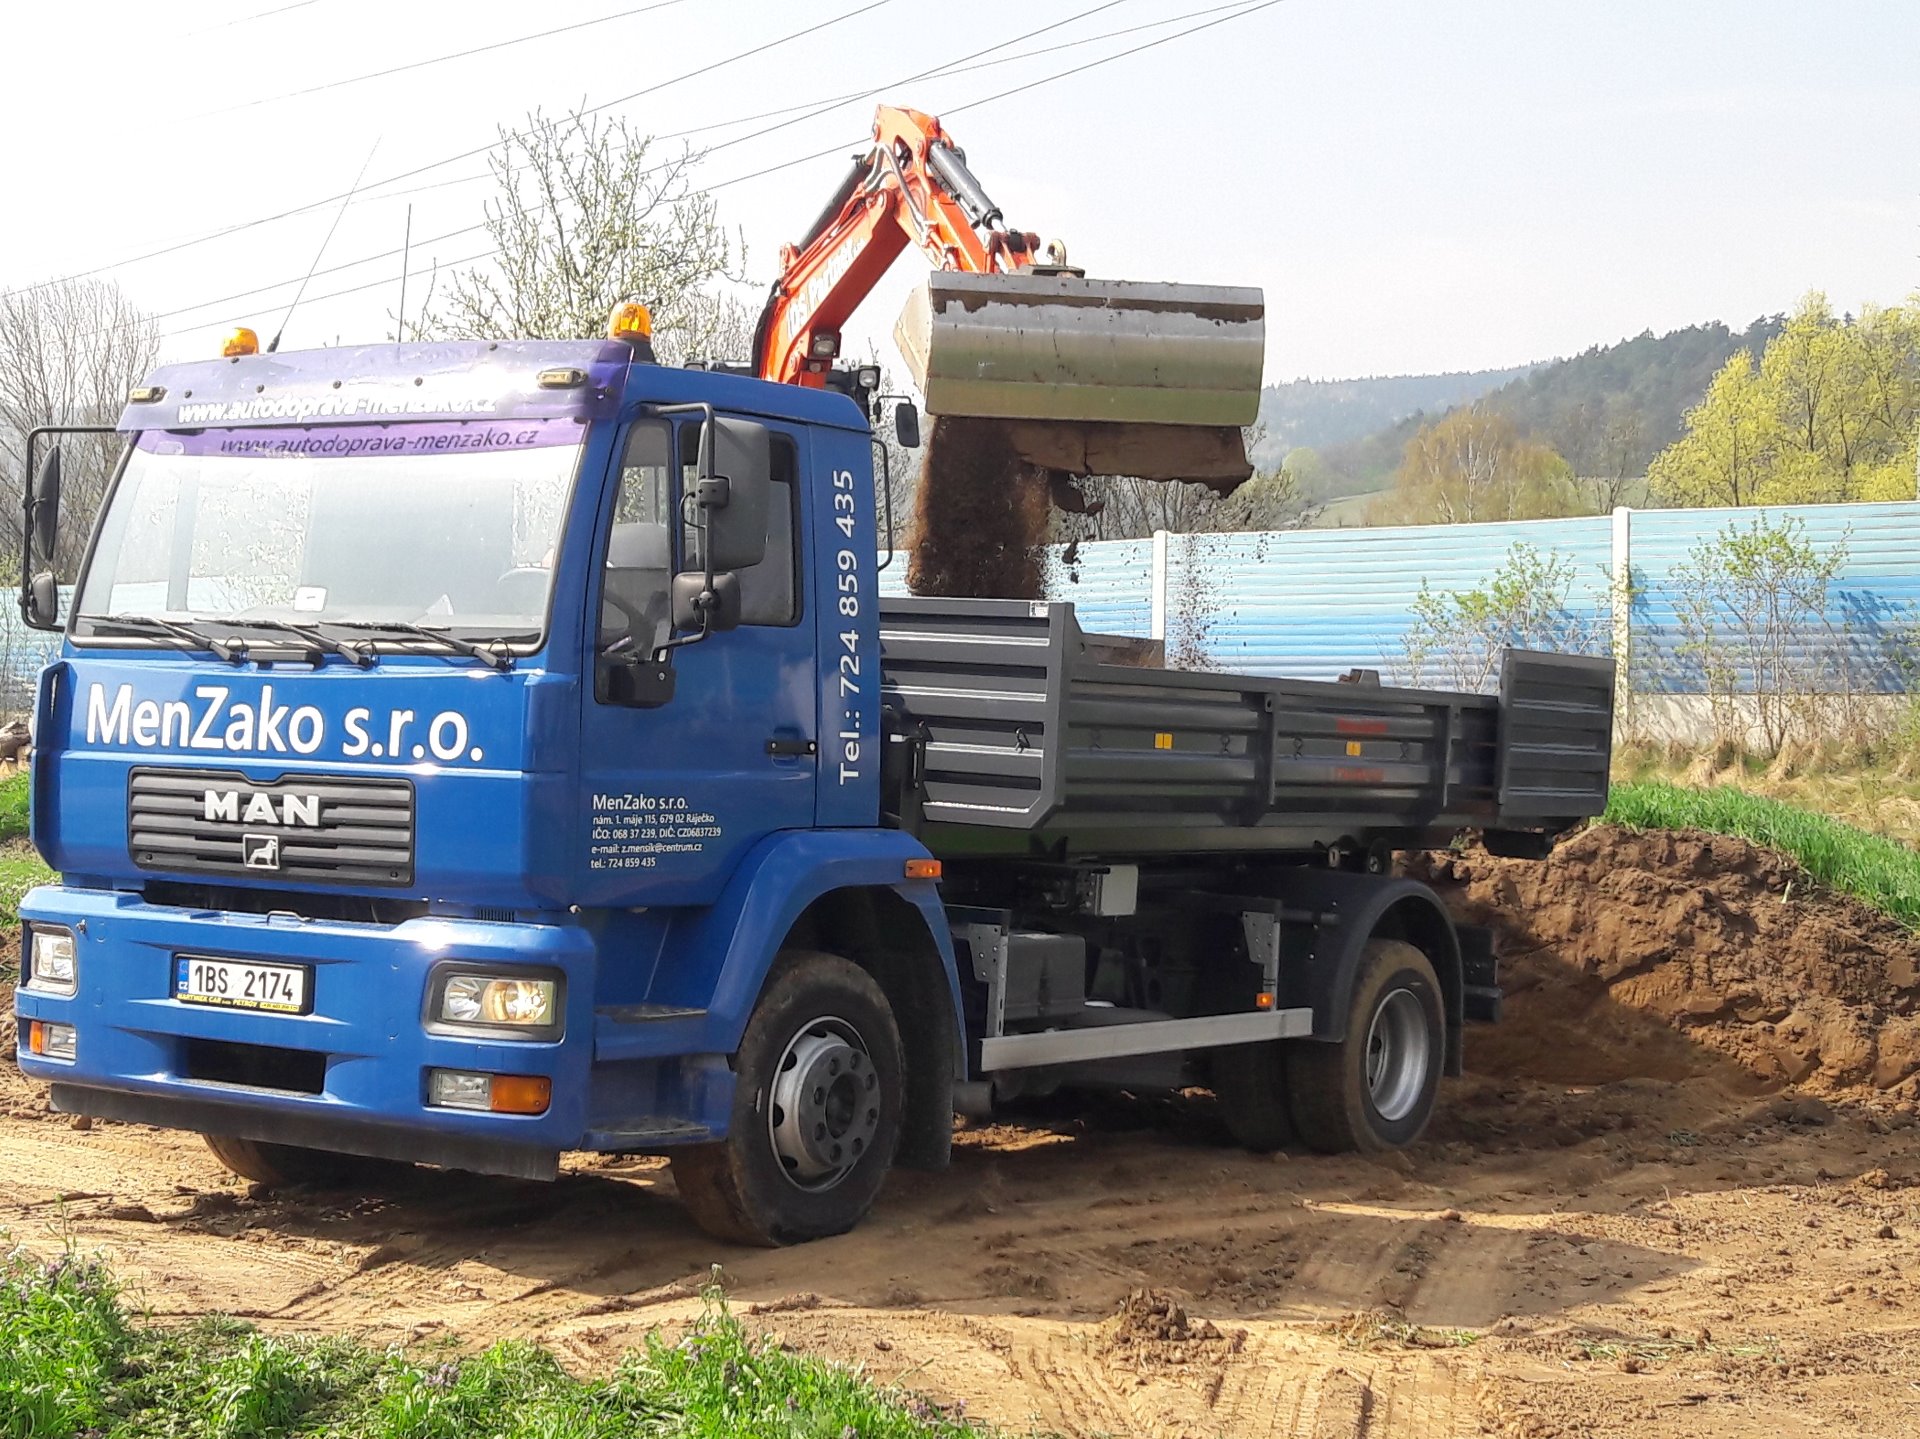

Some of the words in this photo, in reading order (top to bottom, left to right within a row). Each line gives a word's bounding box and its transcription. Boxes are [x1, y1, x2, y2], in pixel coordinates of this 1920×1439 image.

[177, 394, 498, 424] www.autodoprava-menzako.cz
[221, 427, 539, 457] www.autodoprava-menzako.cz
[832, 469, 855, 538] 435
[836, 549, 859, 617] 859
[839, 630, 861, 697] 724
[86, 683, 325, 755] MenZako
[342, 706, 483, 763] s.r.o.
[839, 709, 861, 786] Tel.:
[204, 789, 321, 828] MAN
[592, 793, 656, 810] MenZako
[659, 797, 689, 810] s.r.o.
[592, 814, 613, 825] nám.
[623, 814, 643, 826] máje
[644, 814, 658, 826] 115,
[659, 814, 674, 824] 679
[675, 813, 685, 823] 02
[686, 813, 715, 826] Ráječko
[592, 827, 611, 839] IČO:
[612, 830, 628, 839] 068
[630, 829, 640, 838] 37
[641, 829, 657, 839] 239,
[659, 826, 676, 838] DIČ:
[677, 826, 722, 838] CZ06837239
[590, 858, 607, 869] tel.:
[608, 858, 623, 868] 724
[624, 857, 640, 867] 859
[641, 857, 656, 867] 435
[591, 843, 620, 854] e-mail:
[621, 842, 703, 854] z.mensik@centrum.cz
[178, 981, 189, 990] CZ
[195, 964, 228, 994] 1BS
[243, 969, 294, 1002] 2174
